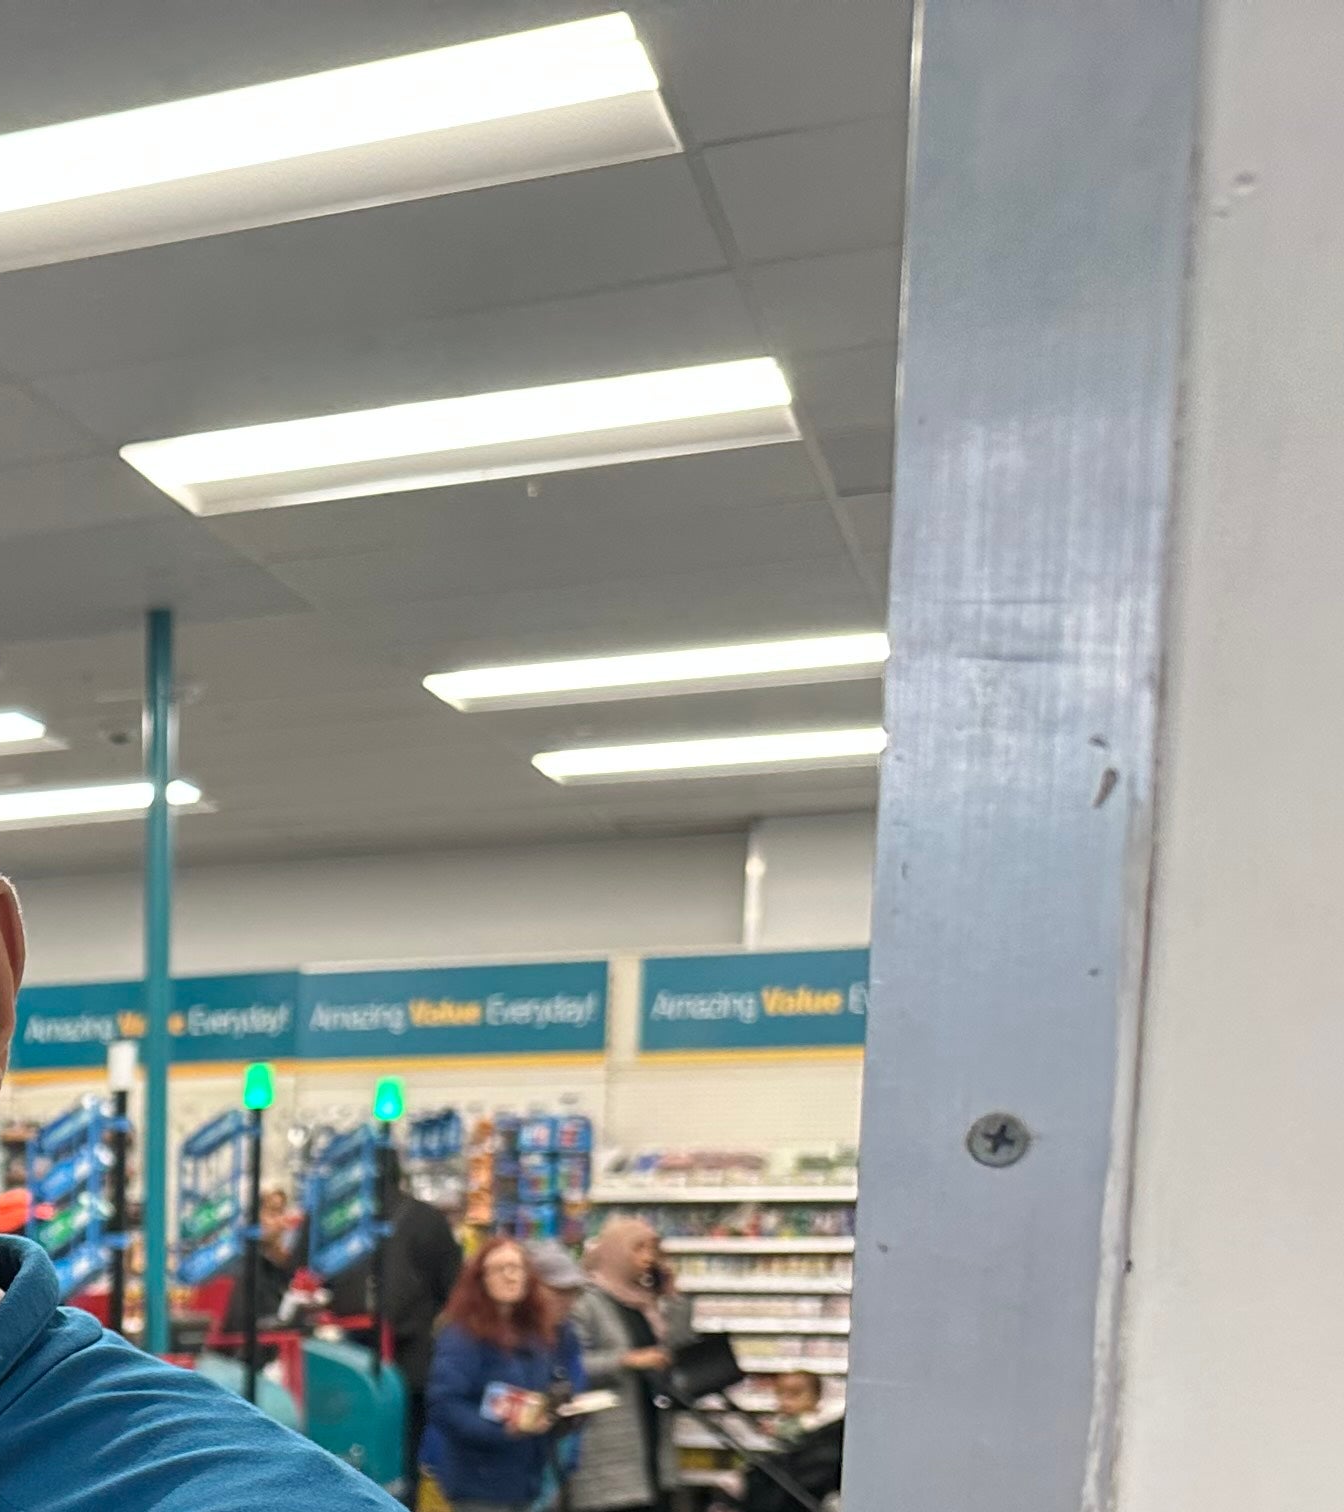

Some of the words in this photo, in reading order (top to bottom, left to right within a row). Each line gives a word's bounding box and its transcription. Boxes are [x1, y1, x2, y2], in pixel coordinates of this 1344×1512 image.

[309, 1002, 407, 1036] Amazing
[408, 998, 482, 1028] Value
[485, 991, 598, 1029] Everyday!
[650, 989, 758, 1024] Amazing
[761, 985, 843, 1016] Value
[24, 1014, 113, 1044] Amazing
